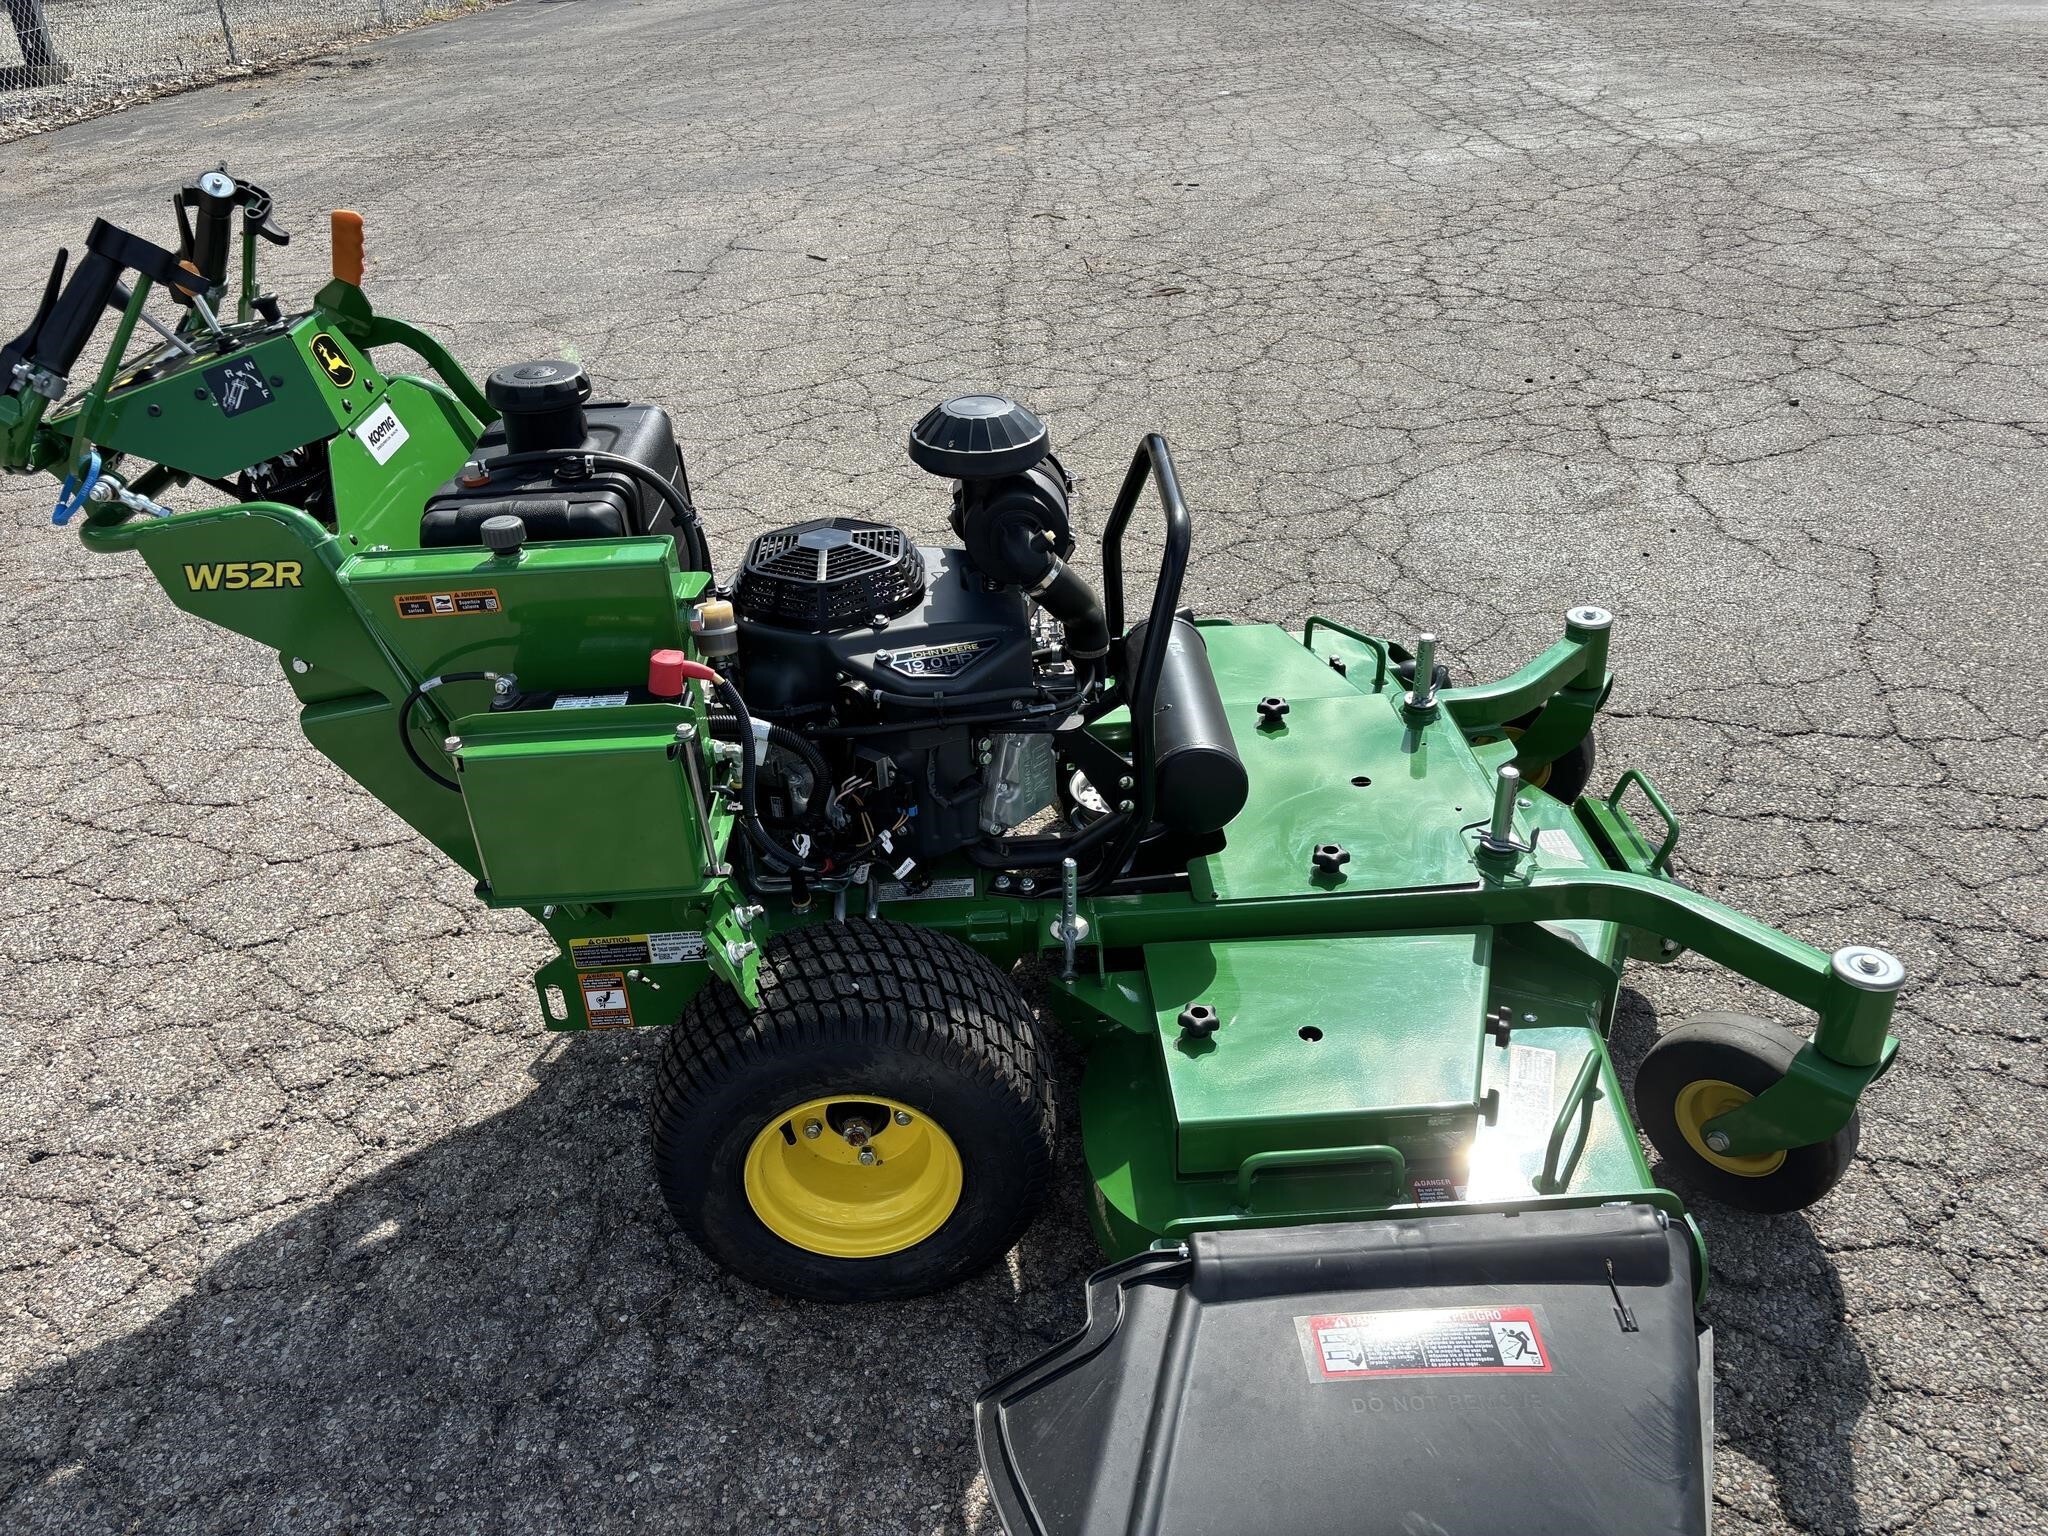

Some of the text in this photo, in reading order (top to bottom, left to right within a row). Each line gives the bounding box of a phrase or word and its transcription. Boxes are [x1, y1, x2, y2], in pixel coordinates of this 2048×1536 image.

[244, 361, 255, 371] N
[224, 369, 234, 378] R
[261, 388, 270, 399] F
[184, 561, 302, 591] W52R
[461, 590, 494, 598] ADVERTENCIA
[911, 643, 979, 659] JOHN DEERE
[904, 658, 943, 673] 19.0
[945, 653, 973, 667] HP
[595, 937, 631, 945] CAUTION
[1420, 1178, 1451, 1187] DANGER
[1452, 1308, 1502, 1322] PELIGRO
[1352, 1396, 1384, 1414] DO
[1392, 1394, 1439, 1412] NOT
